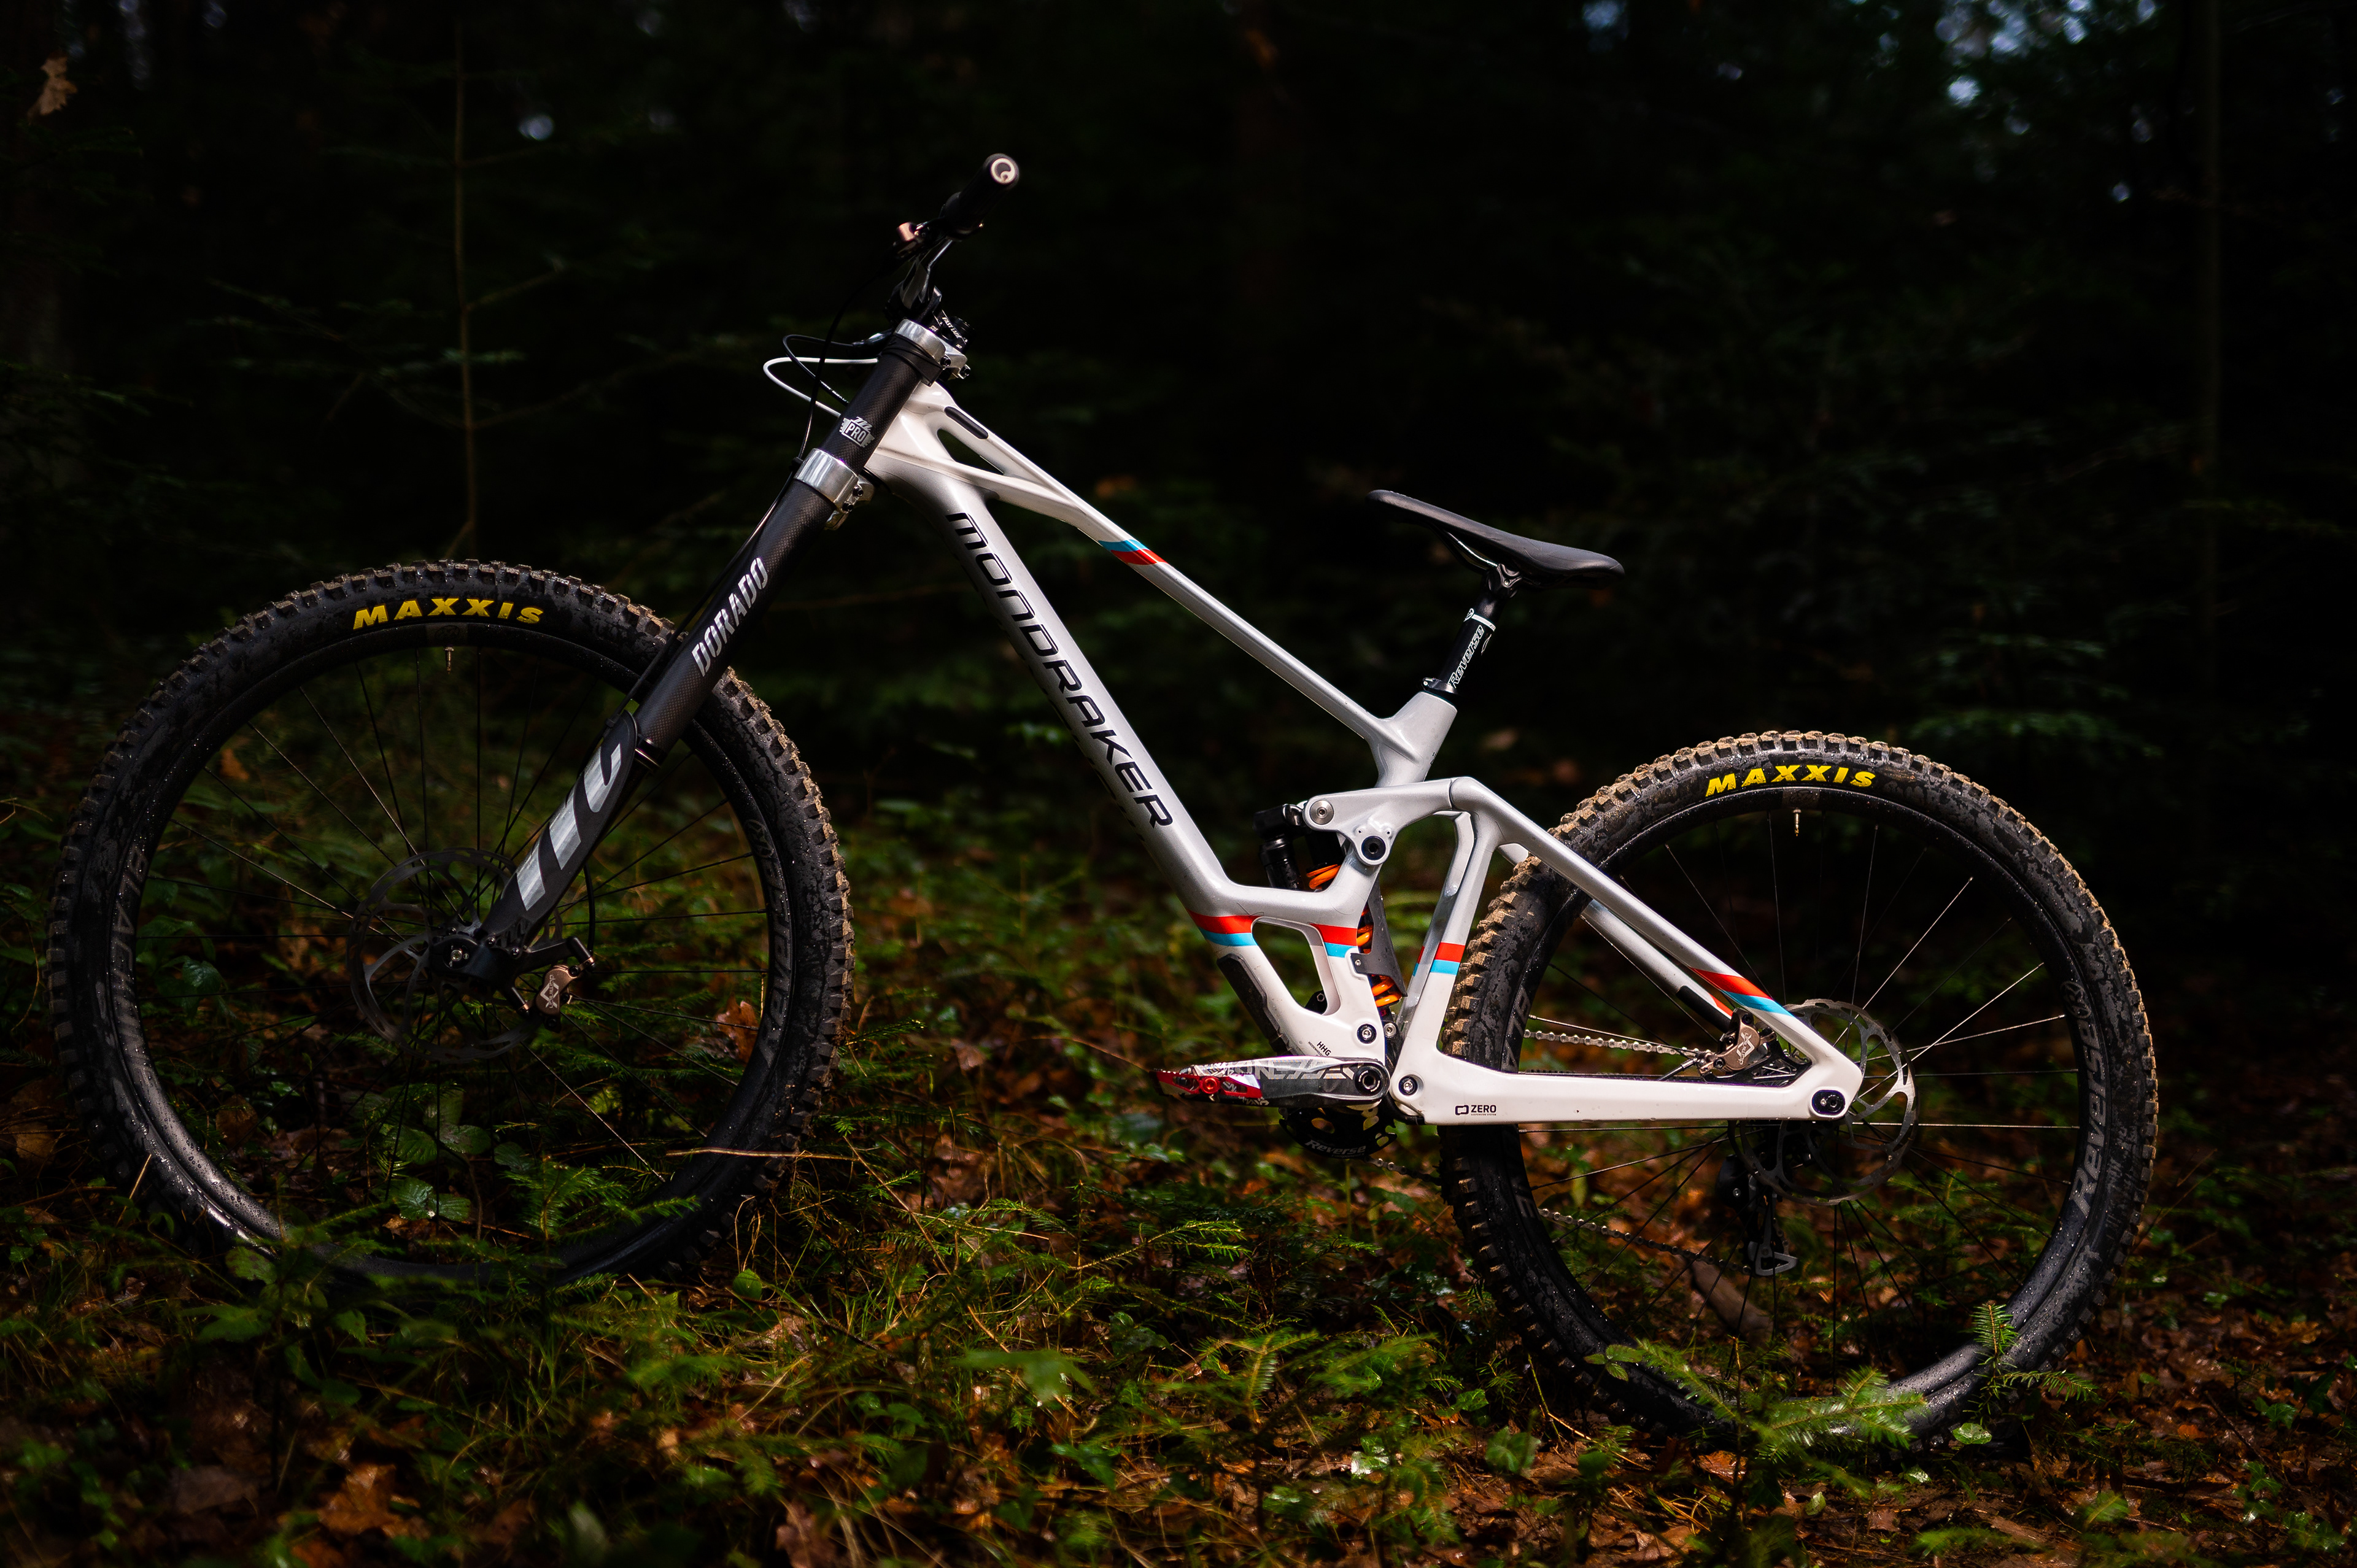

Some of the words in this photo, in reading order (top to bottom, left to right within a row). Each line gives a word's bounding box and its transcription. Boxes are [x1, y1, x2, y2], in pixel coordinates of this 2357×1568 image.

[845, 422, 867, 442] PRO
[354, 598, 543, 629] MAXXIS
[691, 557, 768, 677] DORADO
[946, 512, 1174, 828] MONDRAKER
[1447, 625, 1484, 689] Reverse
[1706, 765, 1875, 797] MAXXIS
[757, 857, 792, 1068] Reverse
[1317, 1041, 1331, 1056] HHG
[2069, 1018, 2107, 1219] Reverse
[1304, 1139, 1366, 1155] Reverse
